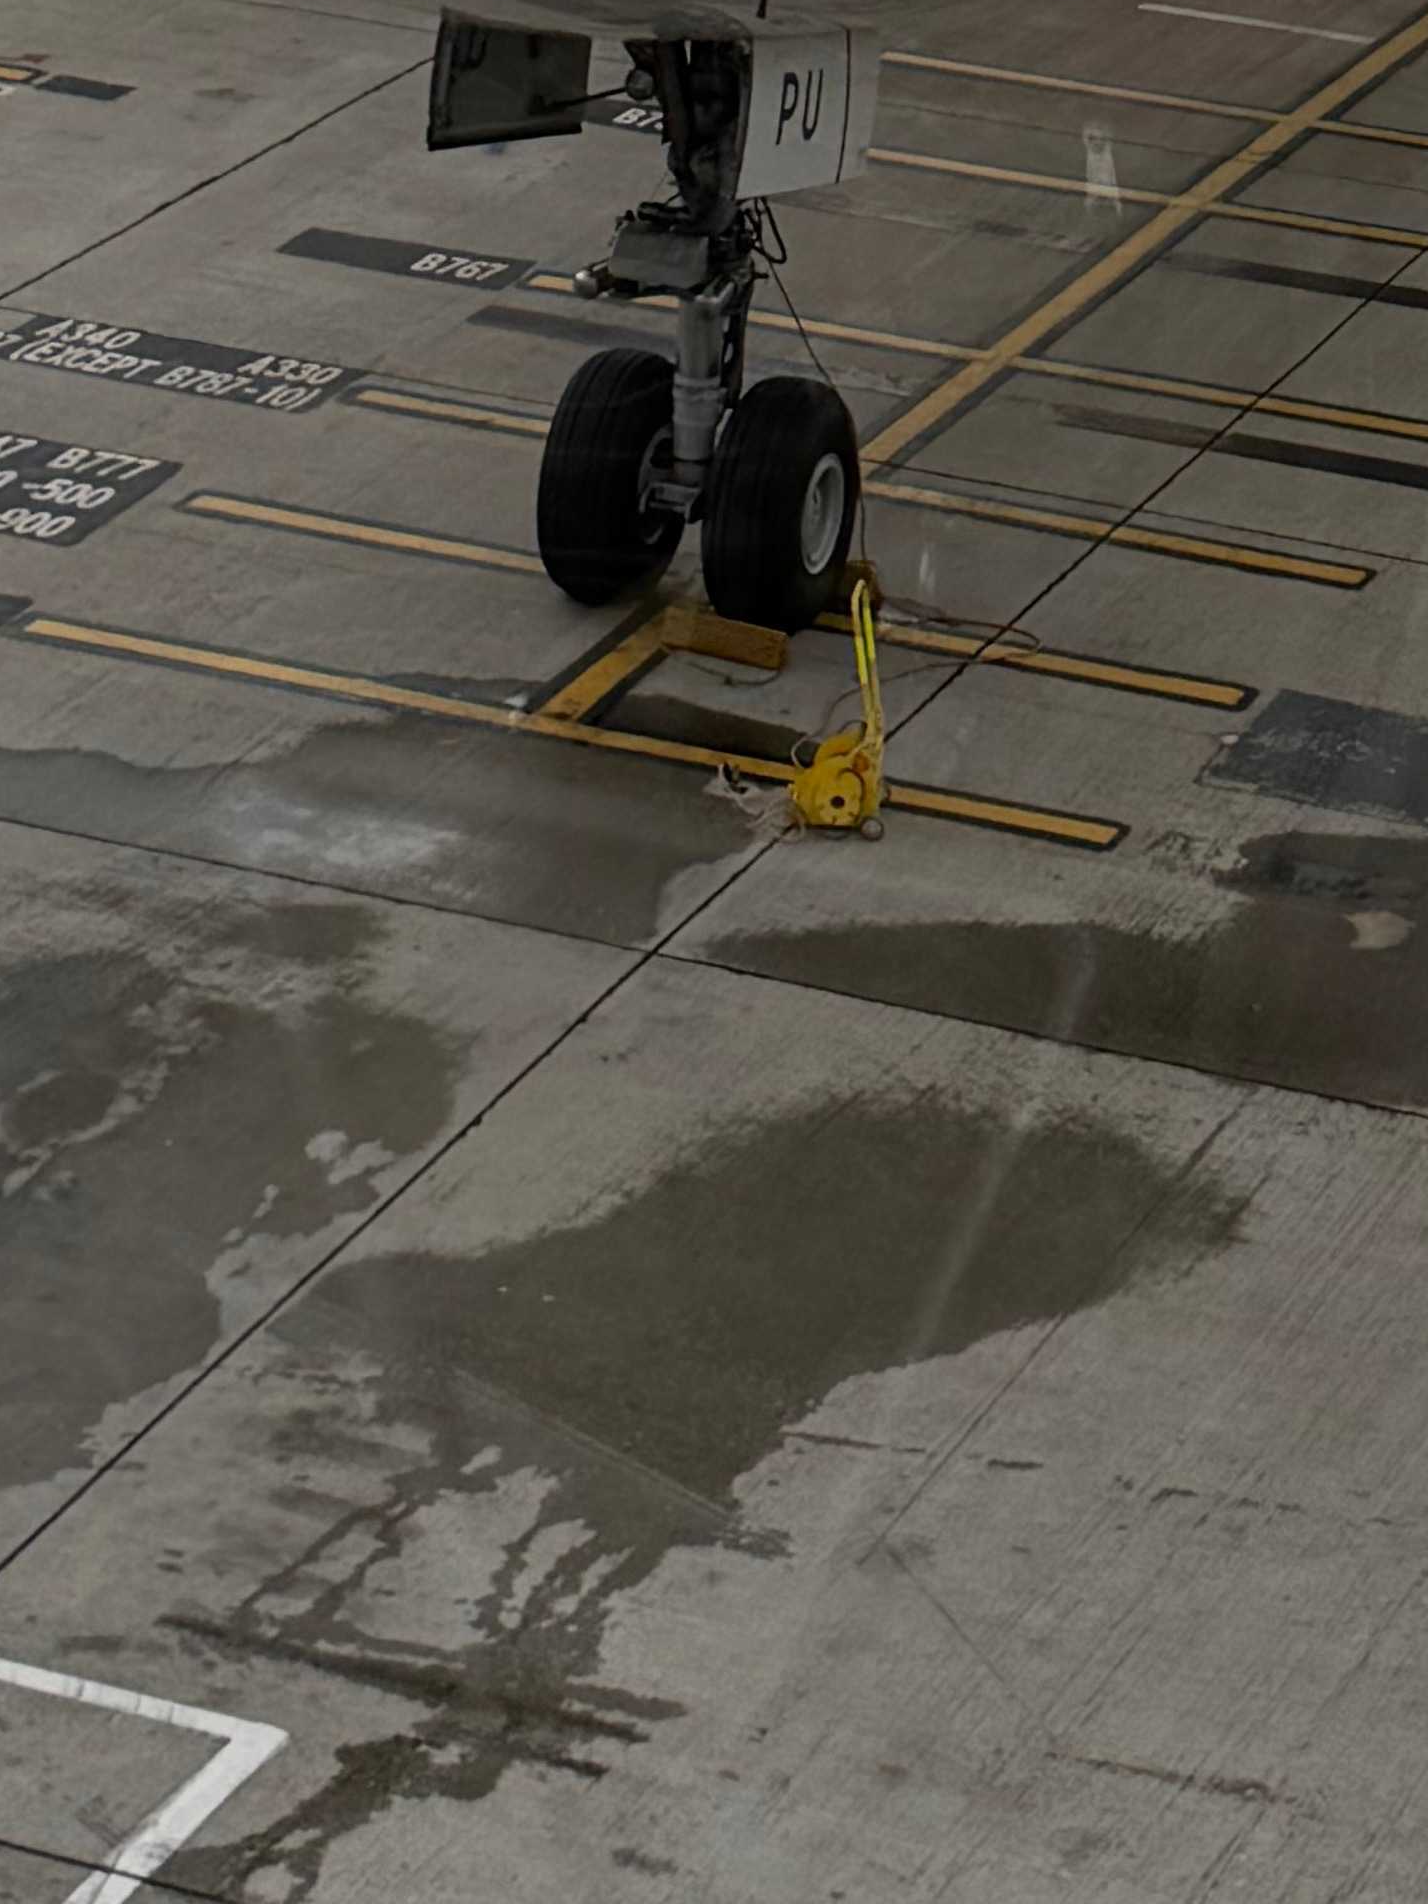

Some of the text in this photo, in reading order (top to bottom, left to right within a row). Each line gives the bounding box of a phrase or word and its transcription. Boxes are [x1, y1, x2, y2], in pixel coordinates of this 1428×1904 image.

[775, 68, 824, 146] PU
[410, 252, 509, 281] B767
[9, 337, 162, 380] (EXCEPT
[35, 319, 344, 385] A340 A330
[46, 447, 162, 480] B777
